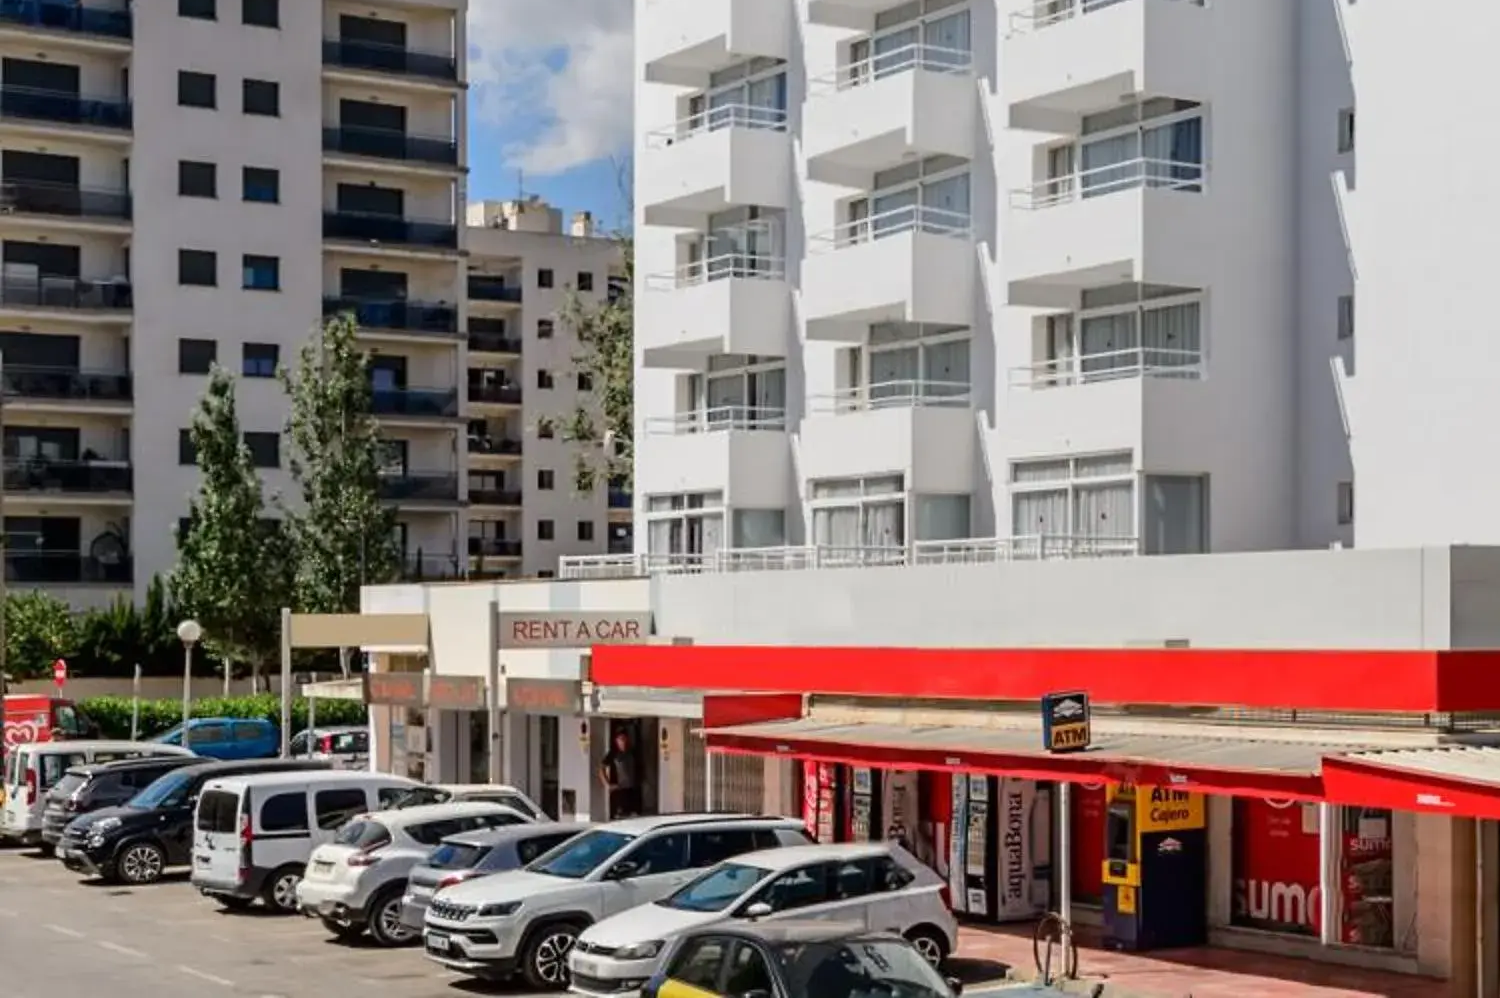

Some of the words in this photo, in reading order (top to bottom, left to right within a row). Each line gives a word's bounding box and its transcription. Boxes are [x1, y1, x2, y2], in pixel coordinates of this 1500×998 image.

[512, 620, 570, 640] RENT
[576, 620, 592, 639] A
[595, 619, 640, 639] CAR
[1054, 727, 1087, 746] ATM
[1150, 806, 1190, 823] Cajero
